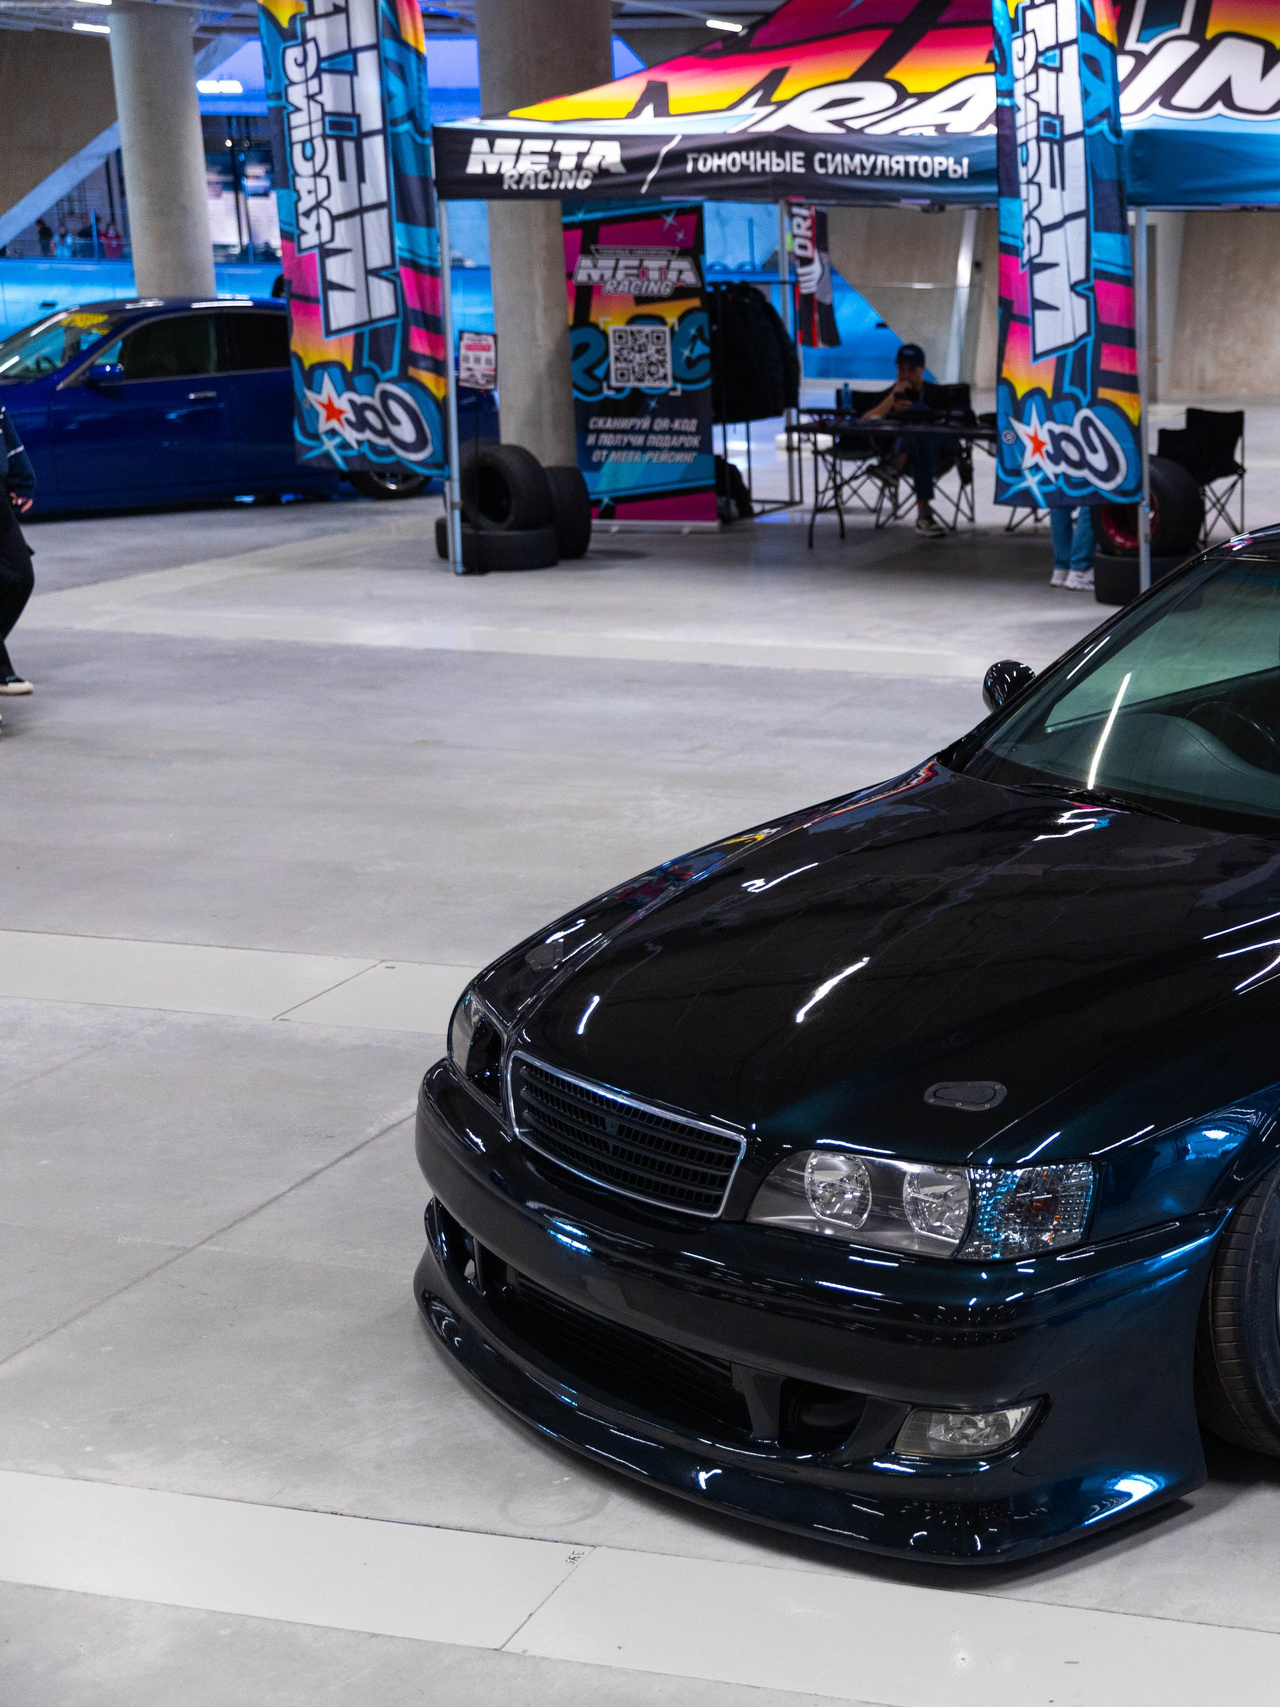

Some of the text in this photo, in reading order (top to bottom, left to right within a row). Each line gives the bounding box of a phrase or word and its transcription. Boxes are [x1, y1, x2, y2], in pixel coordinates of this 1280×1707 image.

[465, 137, 627, 174] META
[686, 151, 970, 179] ГОНОЧНЫЕ СИМУЛЯТОРЫ
[502, 168, 593, 191] RACING
[576, 258, 698, 282] META
[604, 281, 674, 295] RACING
[588, 415, 698, 432] СКАНИРУЙ QR-КОД
[586, 433, 700, 448] И ПОЛУЧИ ПОДАРОК
[592, 449, 608, 463] ОТ
